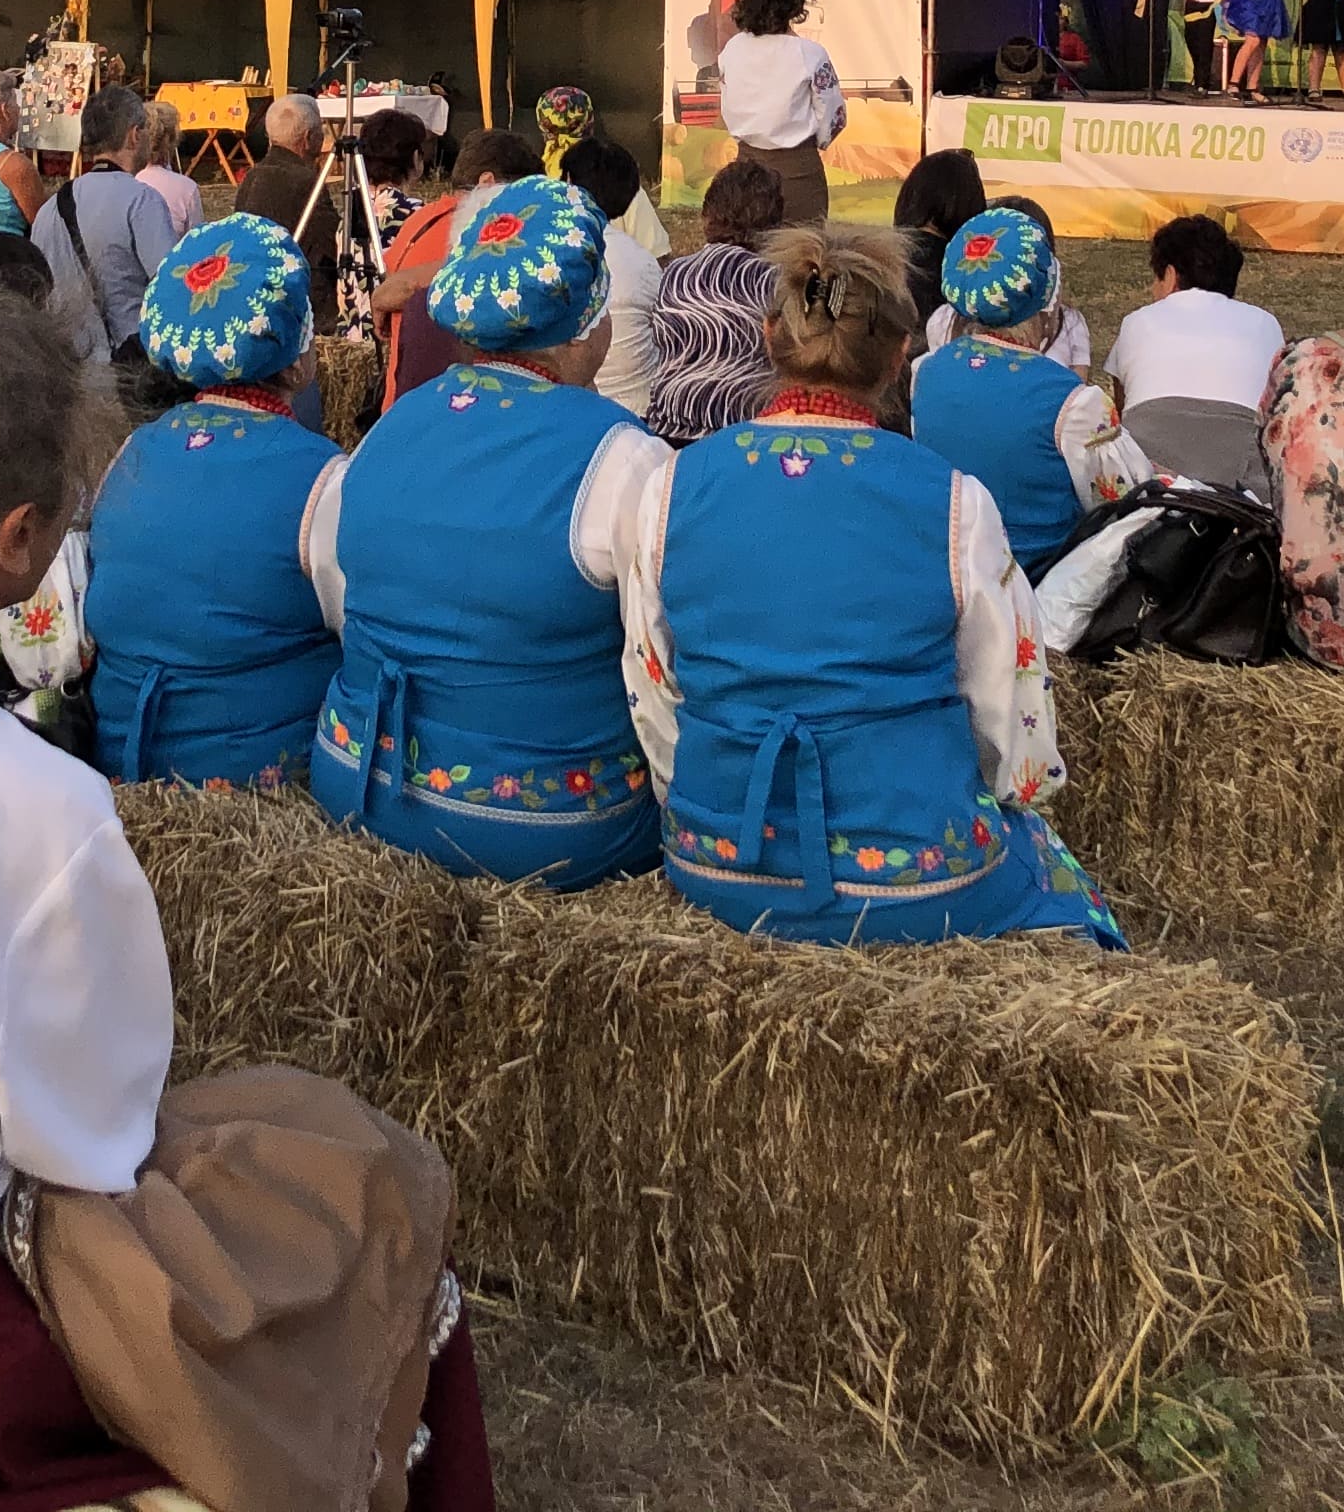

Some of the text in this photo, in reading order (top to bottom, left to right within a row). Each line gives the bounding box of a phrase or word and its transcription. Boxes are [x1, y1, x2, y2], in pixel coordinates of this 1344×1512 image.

[982, 113, 1265, 162] АГРО ТОЛОКА 2020
